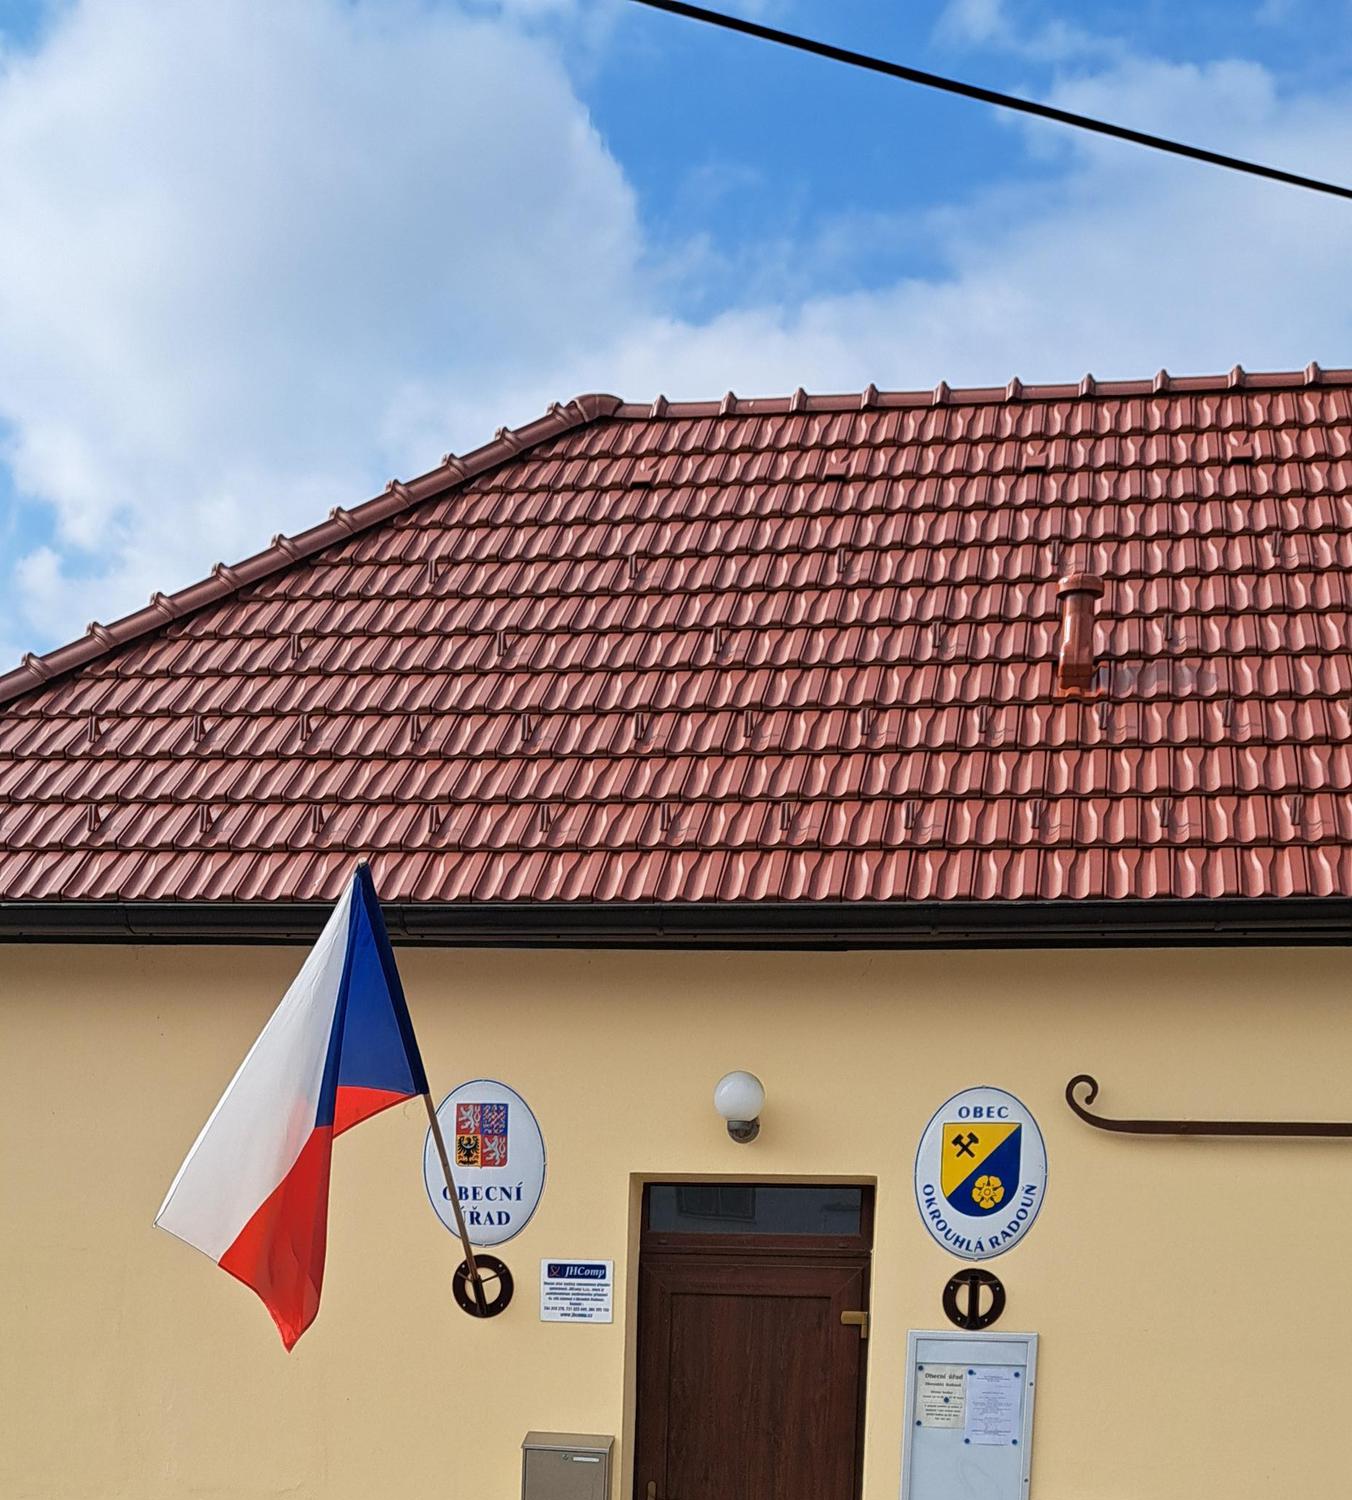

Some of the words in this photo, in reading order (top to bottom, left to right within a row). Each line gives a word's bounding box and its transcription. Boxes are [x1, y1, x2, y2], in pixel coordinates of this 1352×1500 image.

[958, 1106, 1009, 1119] OBEC
[922, 1183, 985, 1253] OKROUHLÁ
[988, 1183, 1038, 1250] RADOUŇ
[564, 1266, 605, 1279] JHComp
